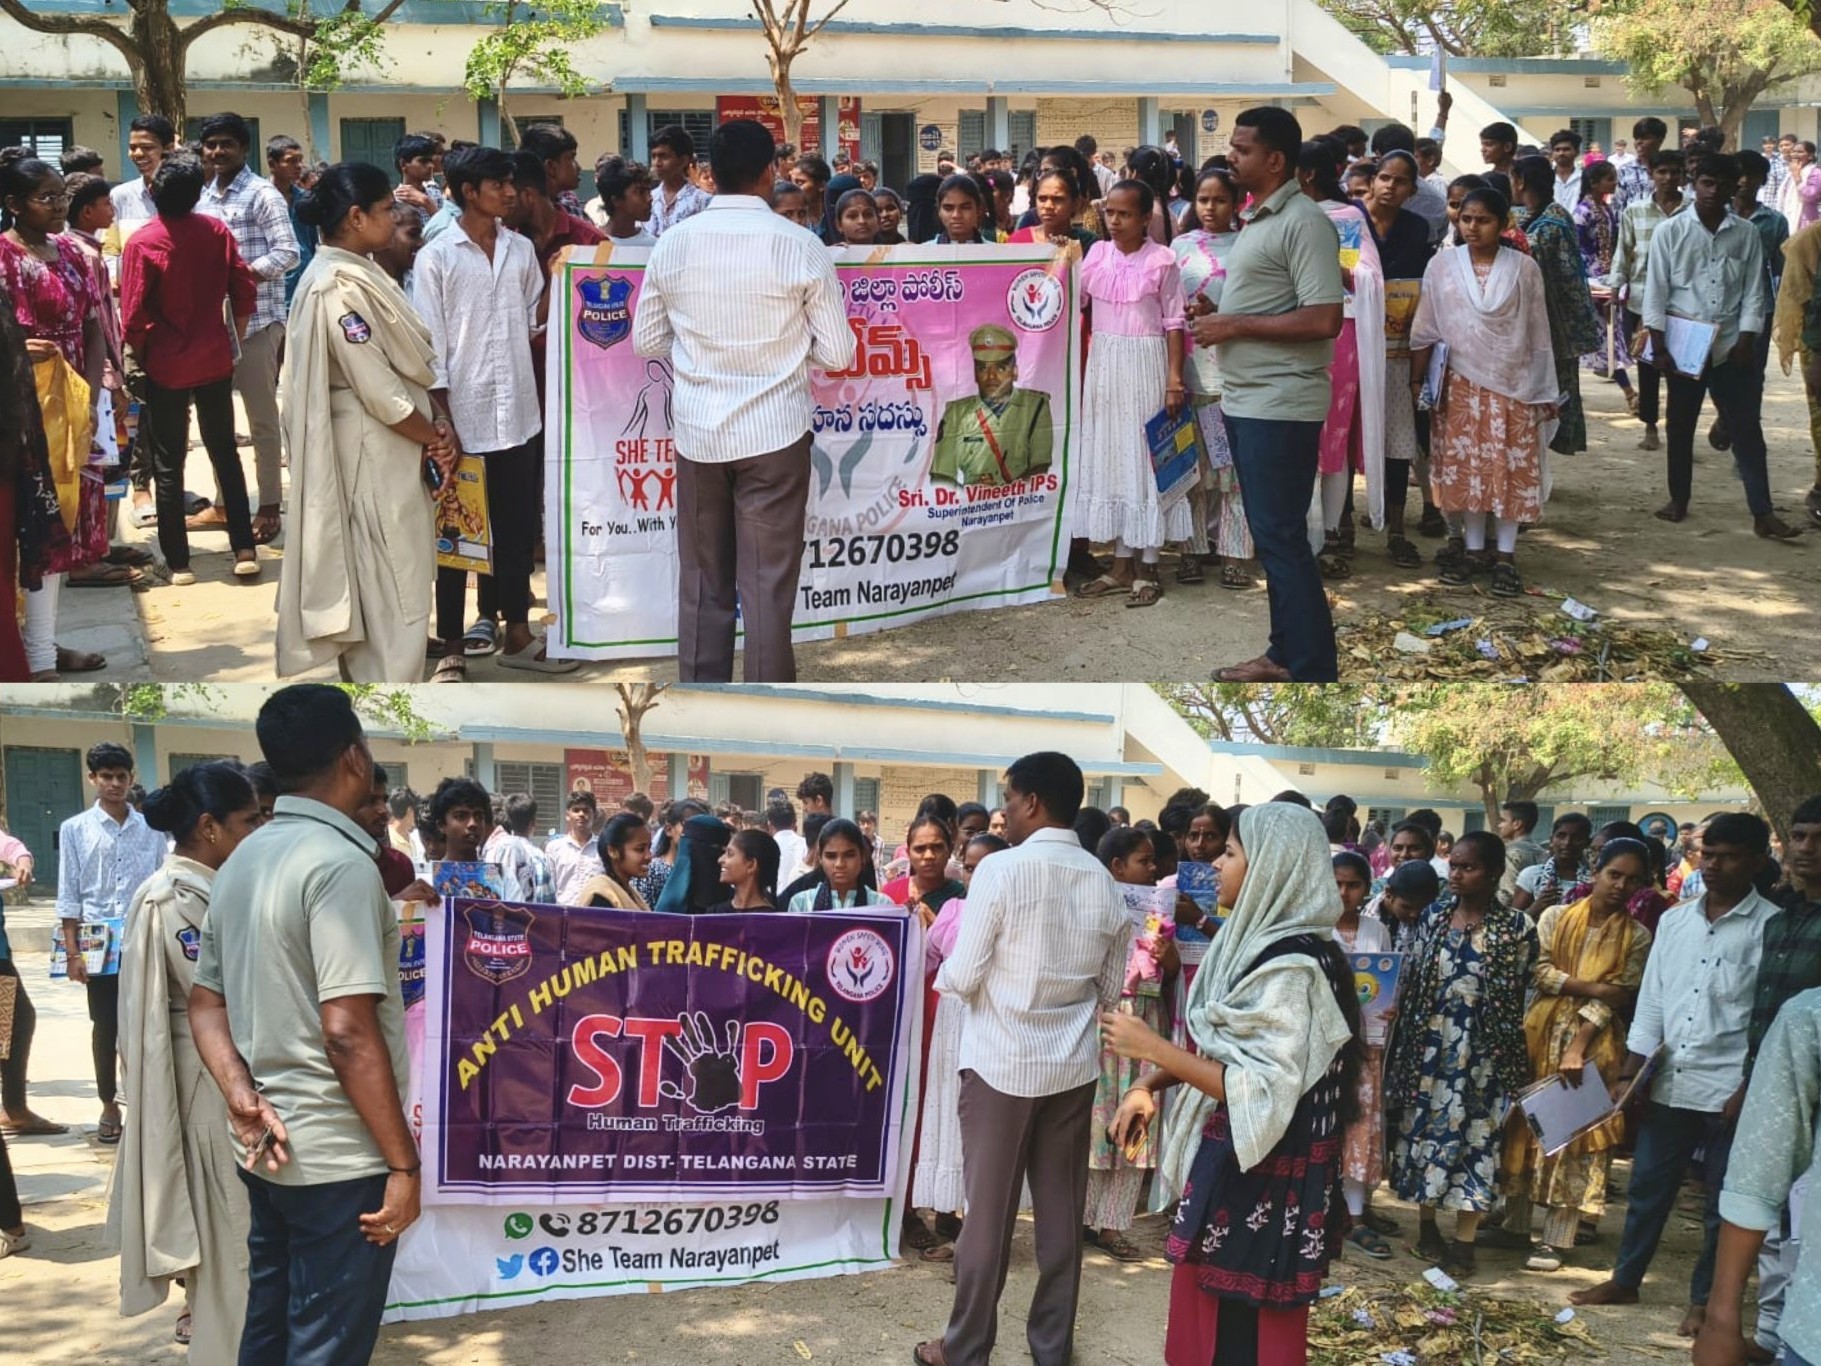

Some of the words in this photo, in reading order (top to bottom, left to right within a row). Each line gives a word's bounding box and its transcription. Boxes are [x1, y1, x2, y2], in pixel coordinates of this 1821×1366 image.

[901, 270, 963, 301] పోలీస్
[583, 310, 627, 321] POLICE
[615, 439, 648, 466] SHE
[654, 438, 677, 464] TE
[898, 488, 930, 508] Sri.
[935, 486, 960, 507] Dr.
[965, 481, 1026, 503] Vineeth
[1029, 473, 1058, 493] IPS
[927, 500, 1002, 519] Superintendent
[1003, 497, 1017, 509] Of
[1017, 494, 1045, 506] Police
[961, 511, 1014, 528] Narayanpet
[581, 520, 603, 536] For
[803, 529, 961, 569] 12670398
[800, 582, 850, 611] Team
[857, 570, 957, 605] Narayanpet
[470, 940, 529, 955] POLICE
[398, 969, 425, 981] OLICE
[456, 1004, 524, 1091] ANTI
[528, 944, 638, 1015] HUMAN
[646, 939, 827, 1025] TRAFFICKING
[831, 1016, 883, 1093] UNIT
[587, 1112, 658, 1132] Human
[662, 1113, 765, 1136] Trafficking
[478, 1153, 617, 1170] NARAYANPET
[680, 1154, 797, 1170] TELANGANA
[802, 1152, 858, 1169] STATE
[576, 1199, 780, 1236] 8712670398
[562, 1248, 603, 1273] She
[608, 1246, 663, 1270] Team
[670, 1239, 780, 1273] Narayanpet
